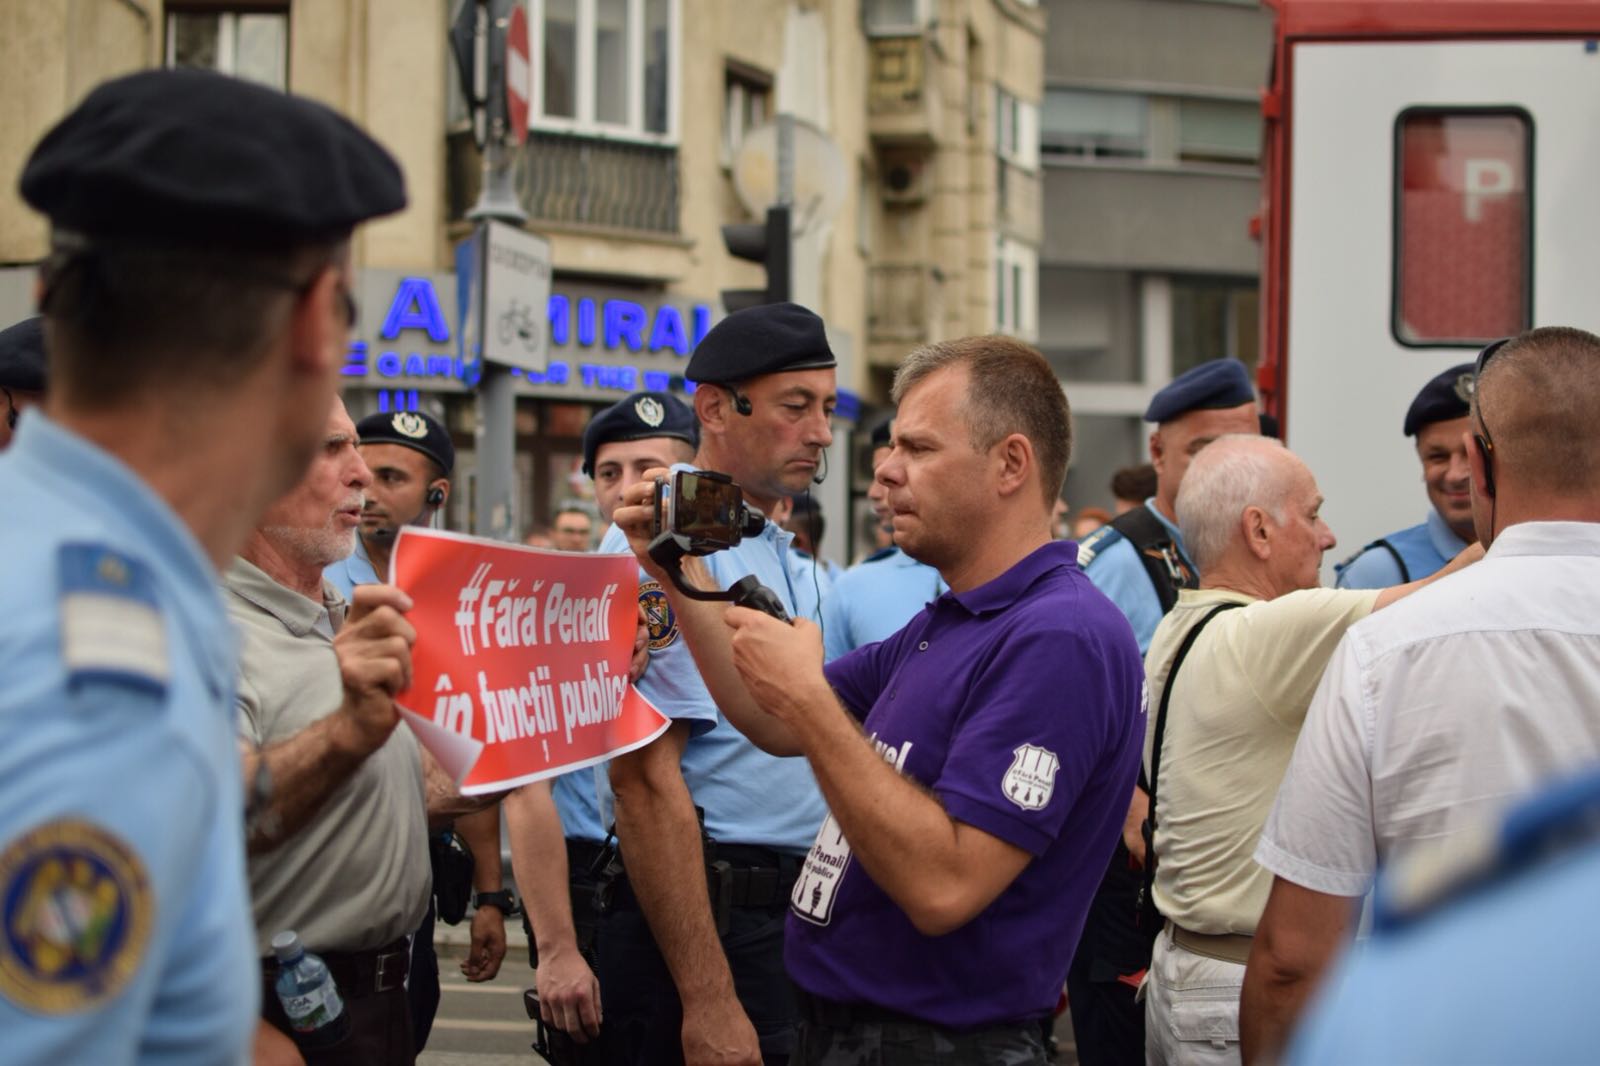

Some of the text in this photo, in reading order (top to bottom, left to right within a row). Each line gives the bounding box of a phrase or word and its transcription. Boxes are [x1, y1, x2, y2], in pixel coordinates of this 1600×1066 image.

[455, 562, 619, 656] #Fără Penali
[815, 845, 845, 869] Penali
